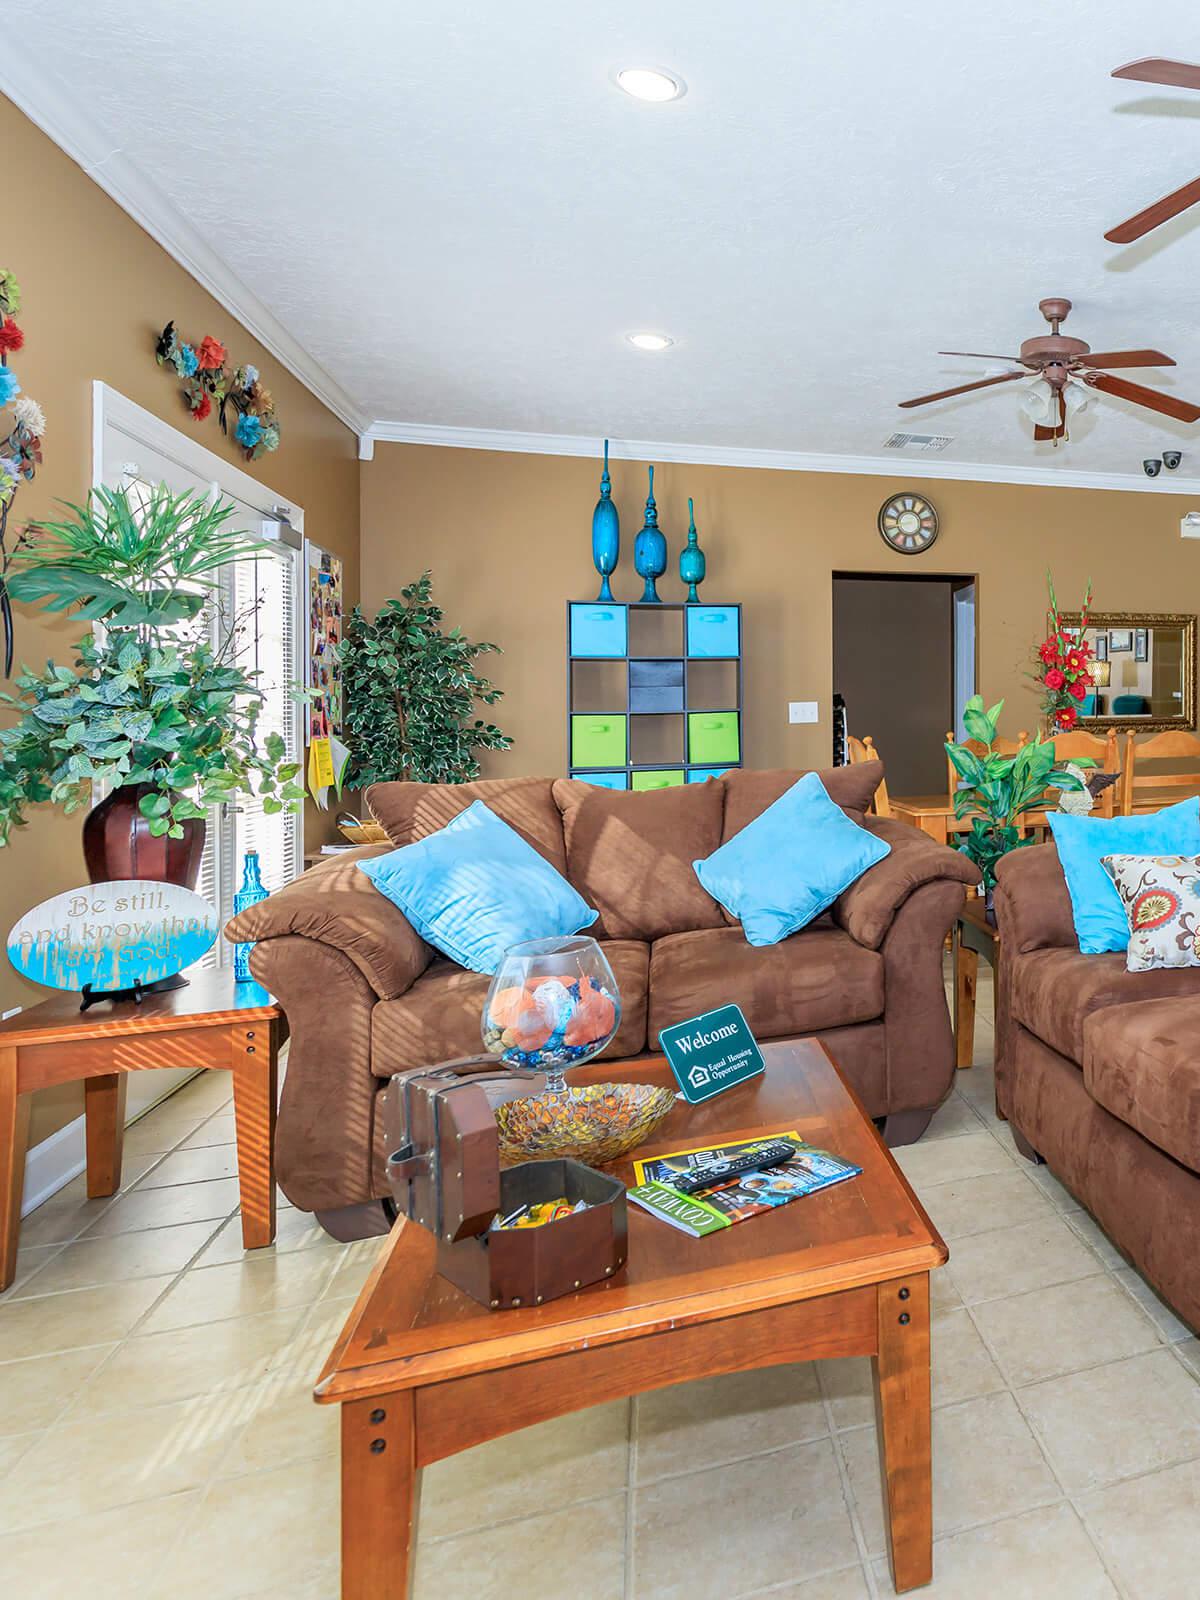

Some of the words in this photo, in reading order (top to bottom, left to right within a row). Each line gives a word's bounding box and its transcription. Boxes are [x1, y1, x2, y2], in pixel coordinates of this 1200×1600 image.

[67, 895, 106, 917] Be
[114, 891, 170, 911] still,
[19, 923, 71, 945] and
[82, 921, 151, 941] know
[161, 914, 211, 935] that
[66, 949, 105, 968] am
[674, 1023, 739, 1055] Welcome
[707, 1057, 727, 1072] Equal
[727, 1048, 753, 1063] Housing
[711, 1060, 748, 1079] Opportunity
[640, 1190, 715, 1227] CONWAY
